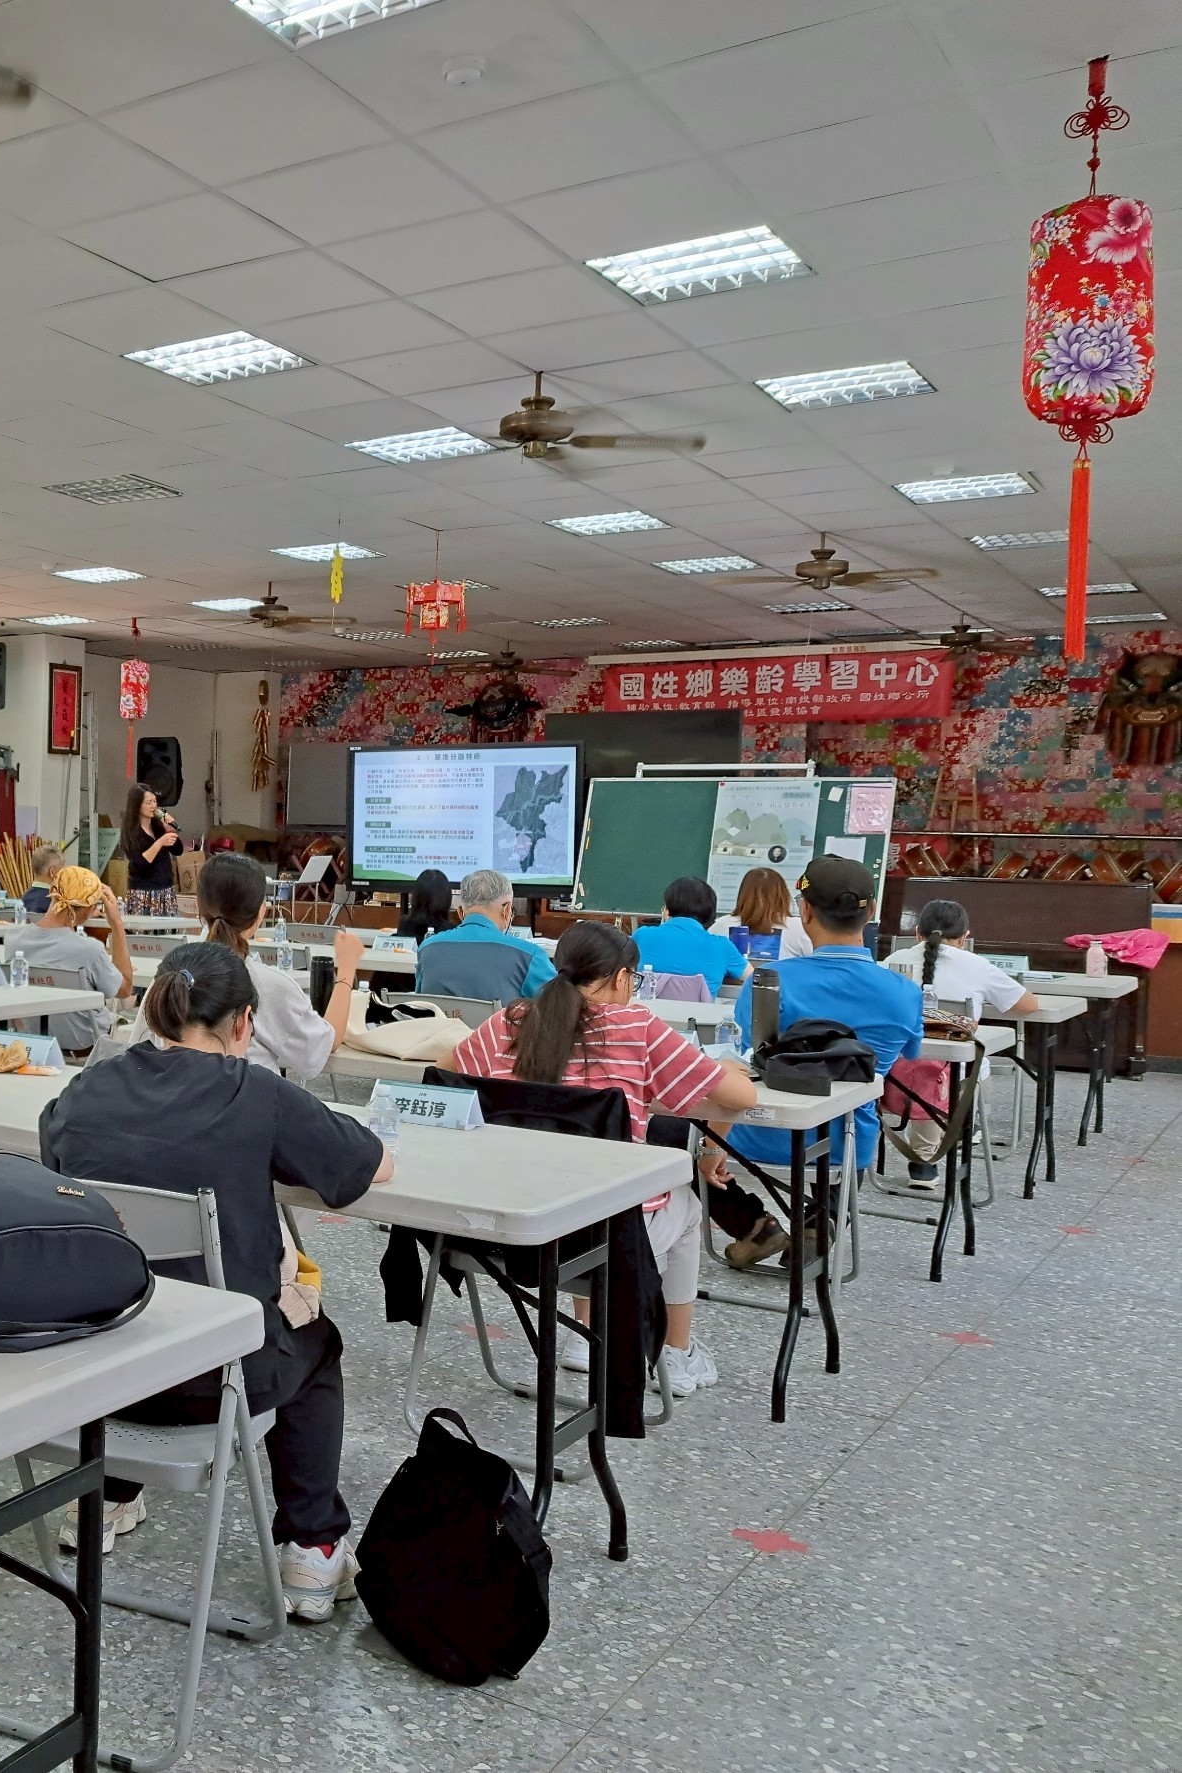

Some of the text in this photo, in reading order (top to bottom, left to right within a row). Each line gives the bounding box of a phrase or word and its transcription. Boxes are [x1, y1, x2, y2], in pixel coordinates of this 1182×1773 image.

[619, 656, 939, 701] 國姓鄉樂齡學習中心
[859, 689, 929, 702] 國姓鄉公所
